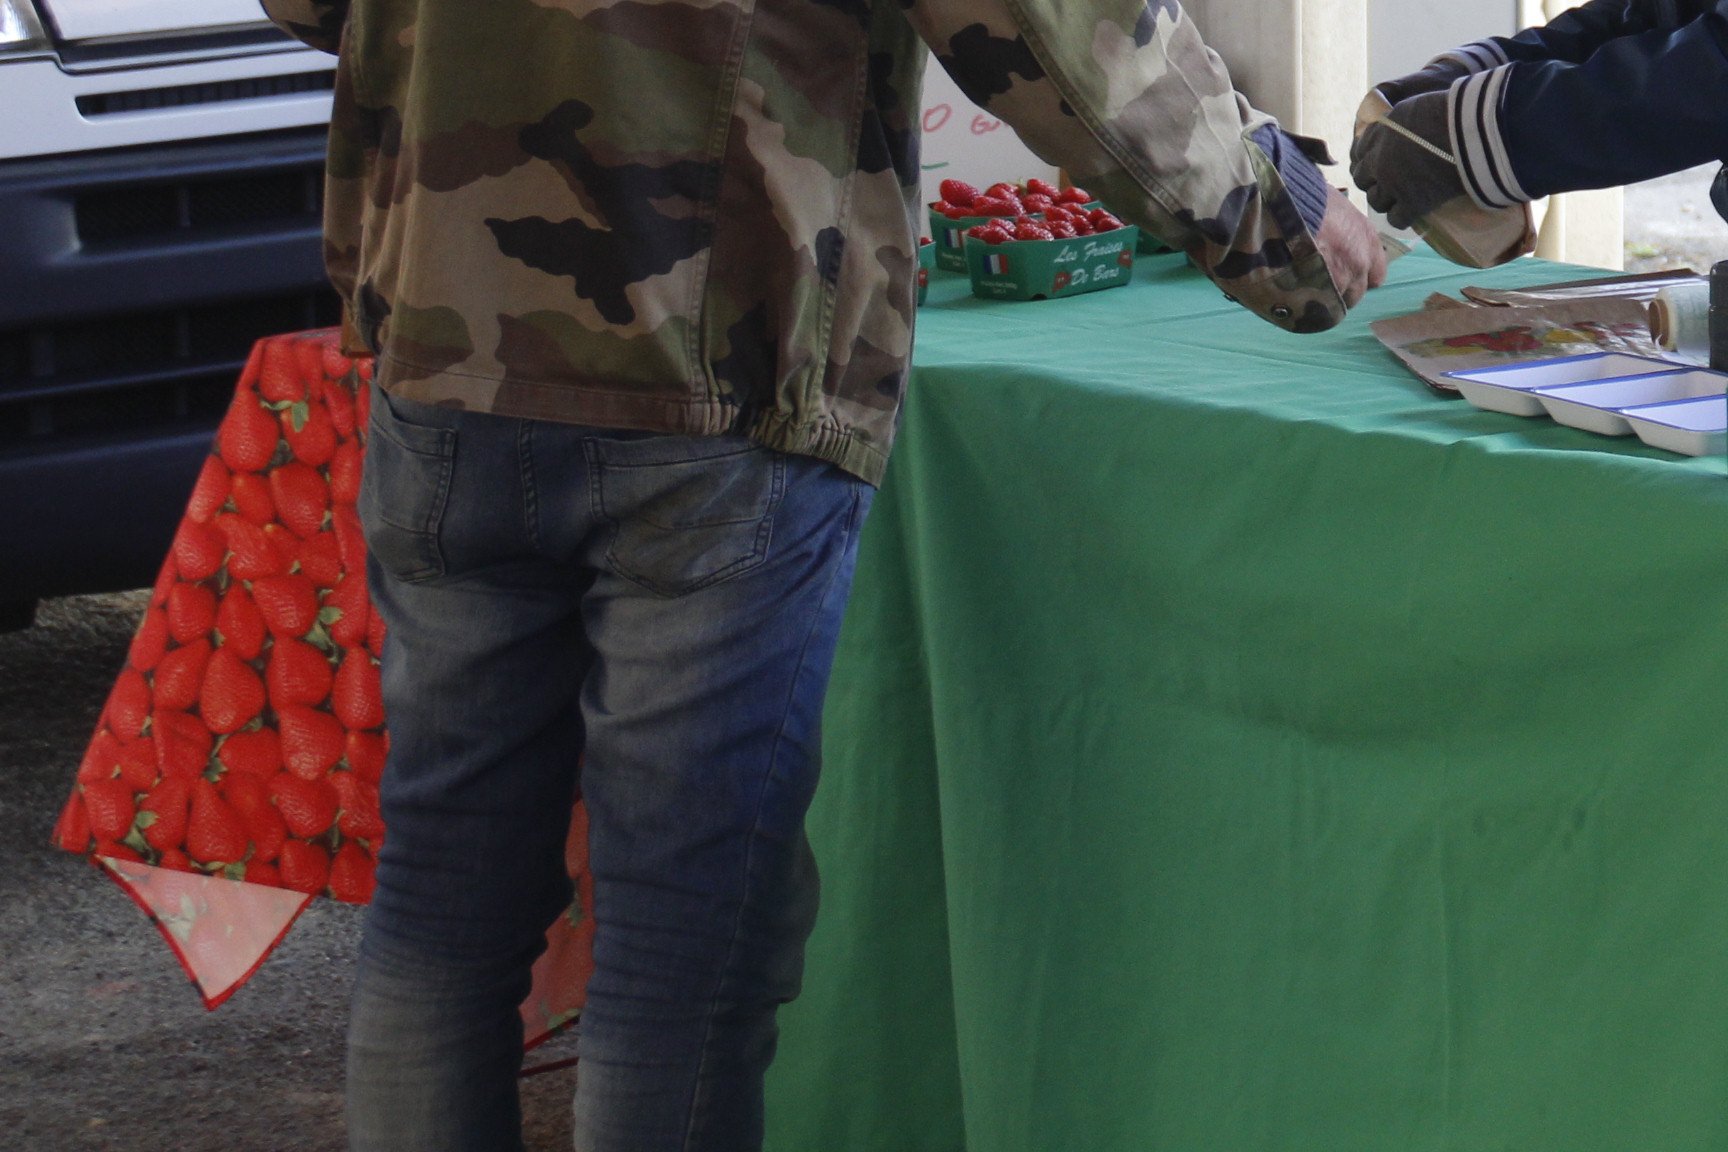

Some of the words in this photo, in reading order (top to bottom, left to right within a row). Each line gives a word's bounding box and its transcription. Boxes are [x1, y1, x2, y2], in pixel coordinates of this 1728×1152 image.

[1054, 245, 1078, 263] Les
[1084, 241, 1123, 262] Fraises
[1071, 268, 1089, 286] De
[1093, 264, 1120, 281] Bars
